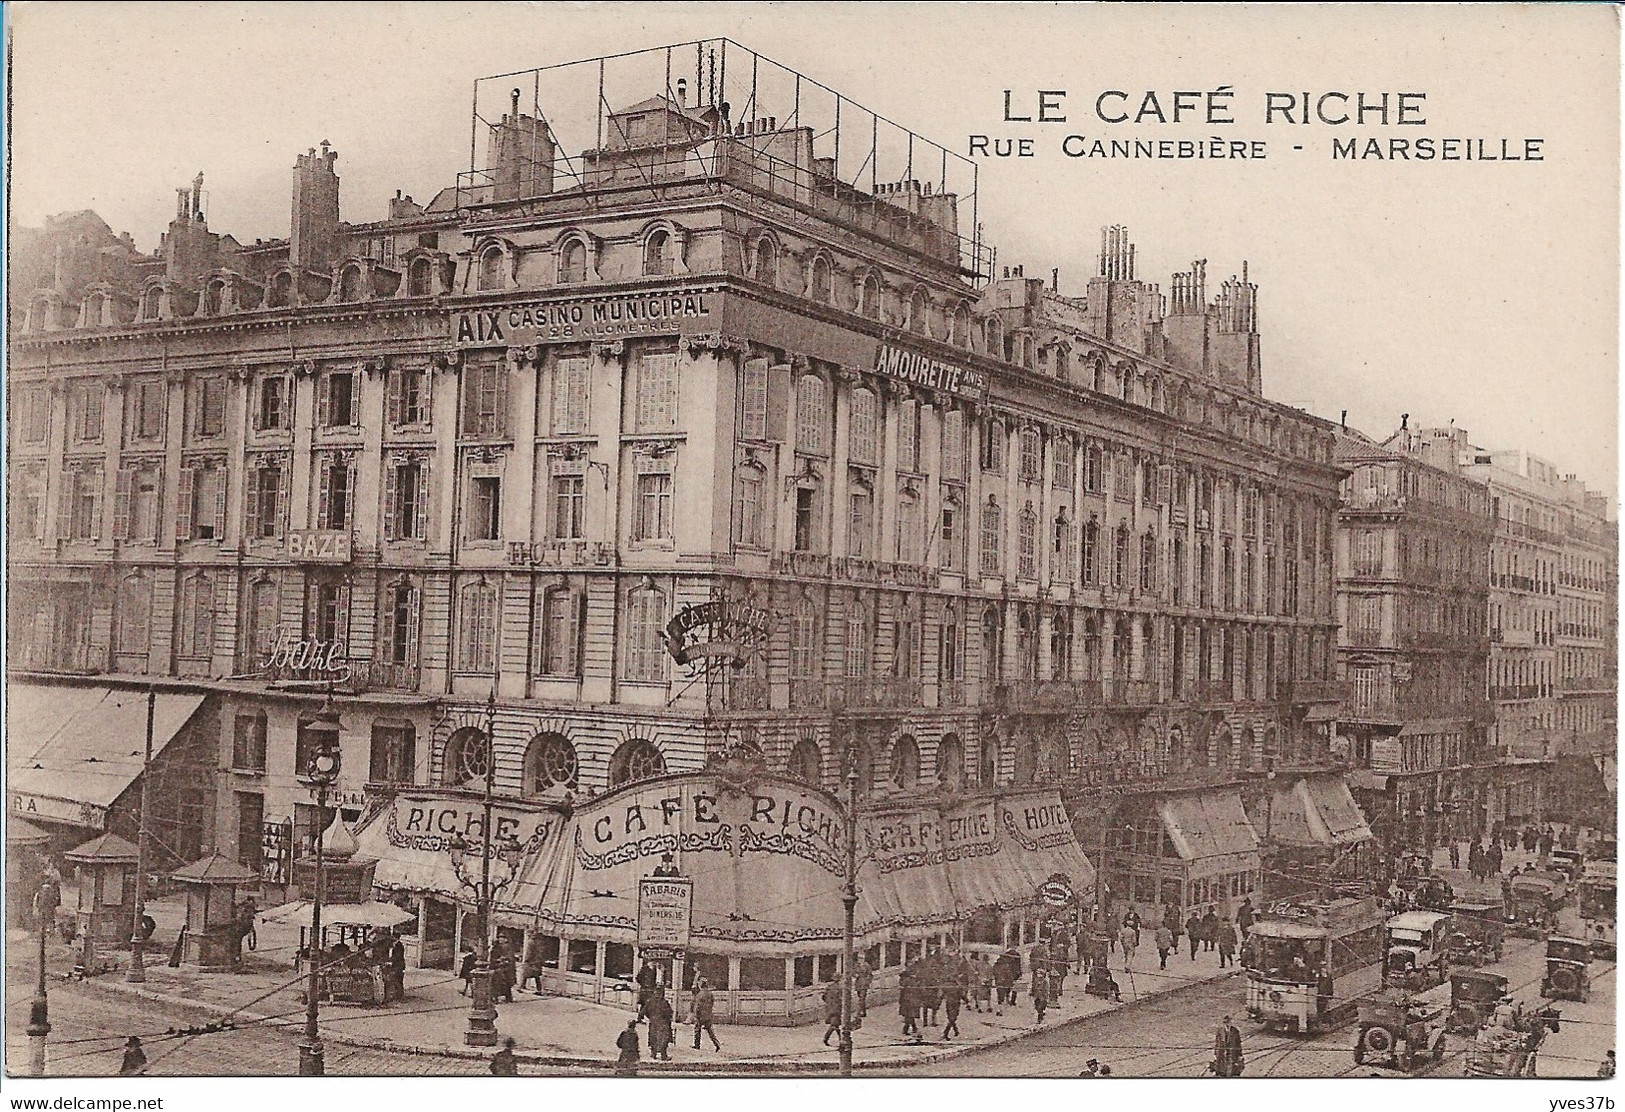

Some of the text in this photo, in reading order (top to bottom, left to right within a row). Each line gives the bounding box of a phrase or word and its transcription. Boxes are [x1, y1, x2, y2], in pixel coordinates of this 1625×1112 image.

[456, 296, 710, 346] AIX CASINO MUNICIPAL
[876, 344, 962, 393] AMOURETTE
[288, 533, 348, 558] BAZE
[507, 541, 613, 567] HOTEL
[405, 806, 521, 842] RICHE
[643, 885, 687, 898] TABARIS
